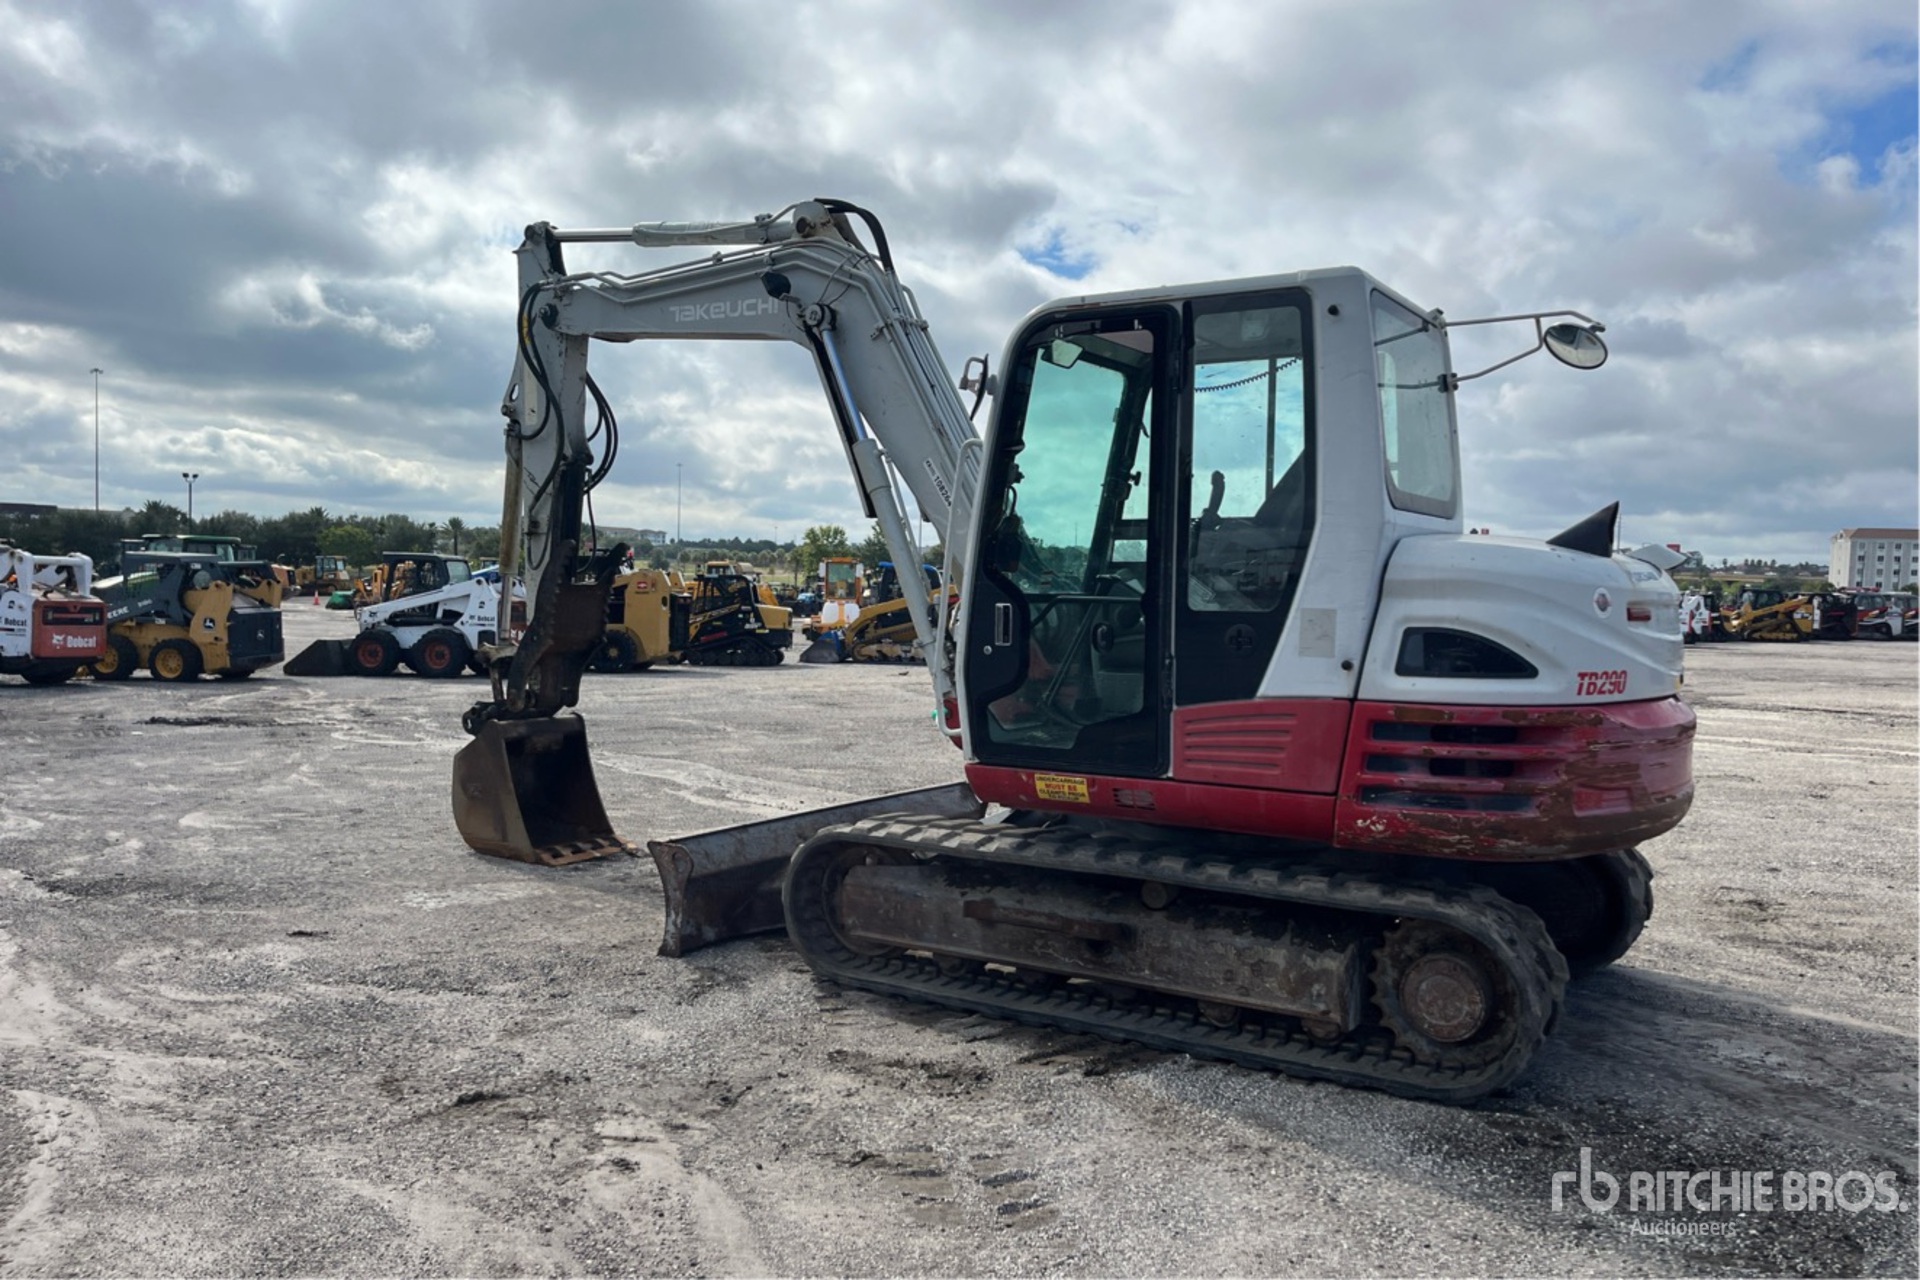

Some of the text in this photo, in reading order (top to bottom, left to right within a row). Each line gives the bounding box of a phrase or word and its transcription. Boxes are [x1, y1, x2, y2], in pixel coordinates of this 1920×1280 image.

[107, 606, 128, 619] EERE
[4, 617, 27, 627] Bobcat
[67, 635, 97, 648] Bobcat
[1577, 670, 1627, 696] TB290
